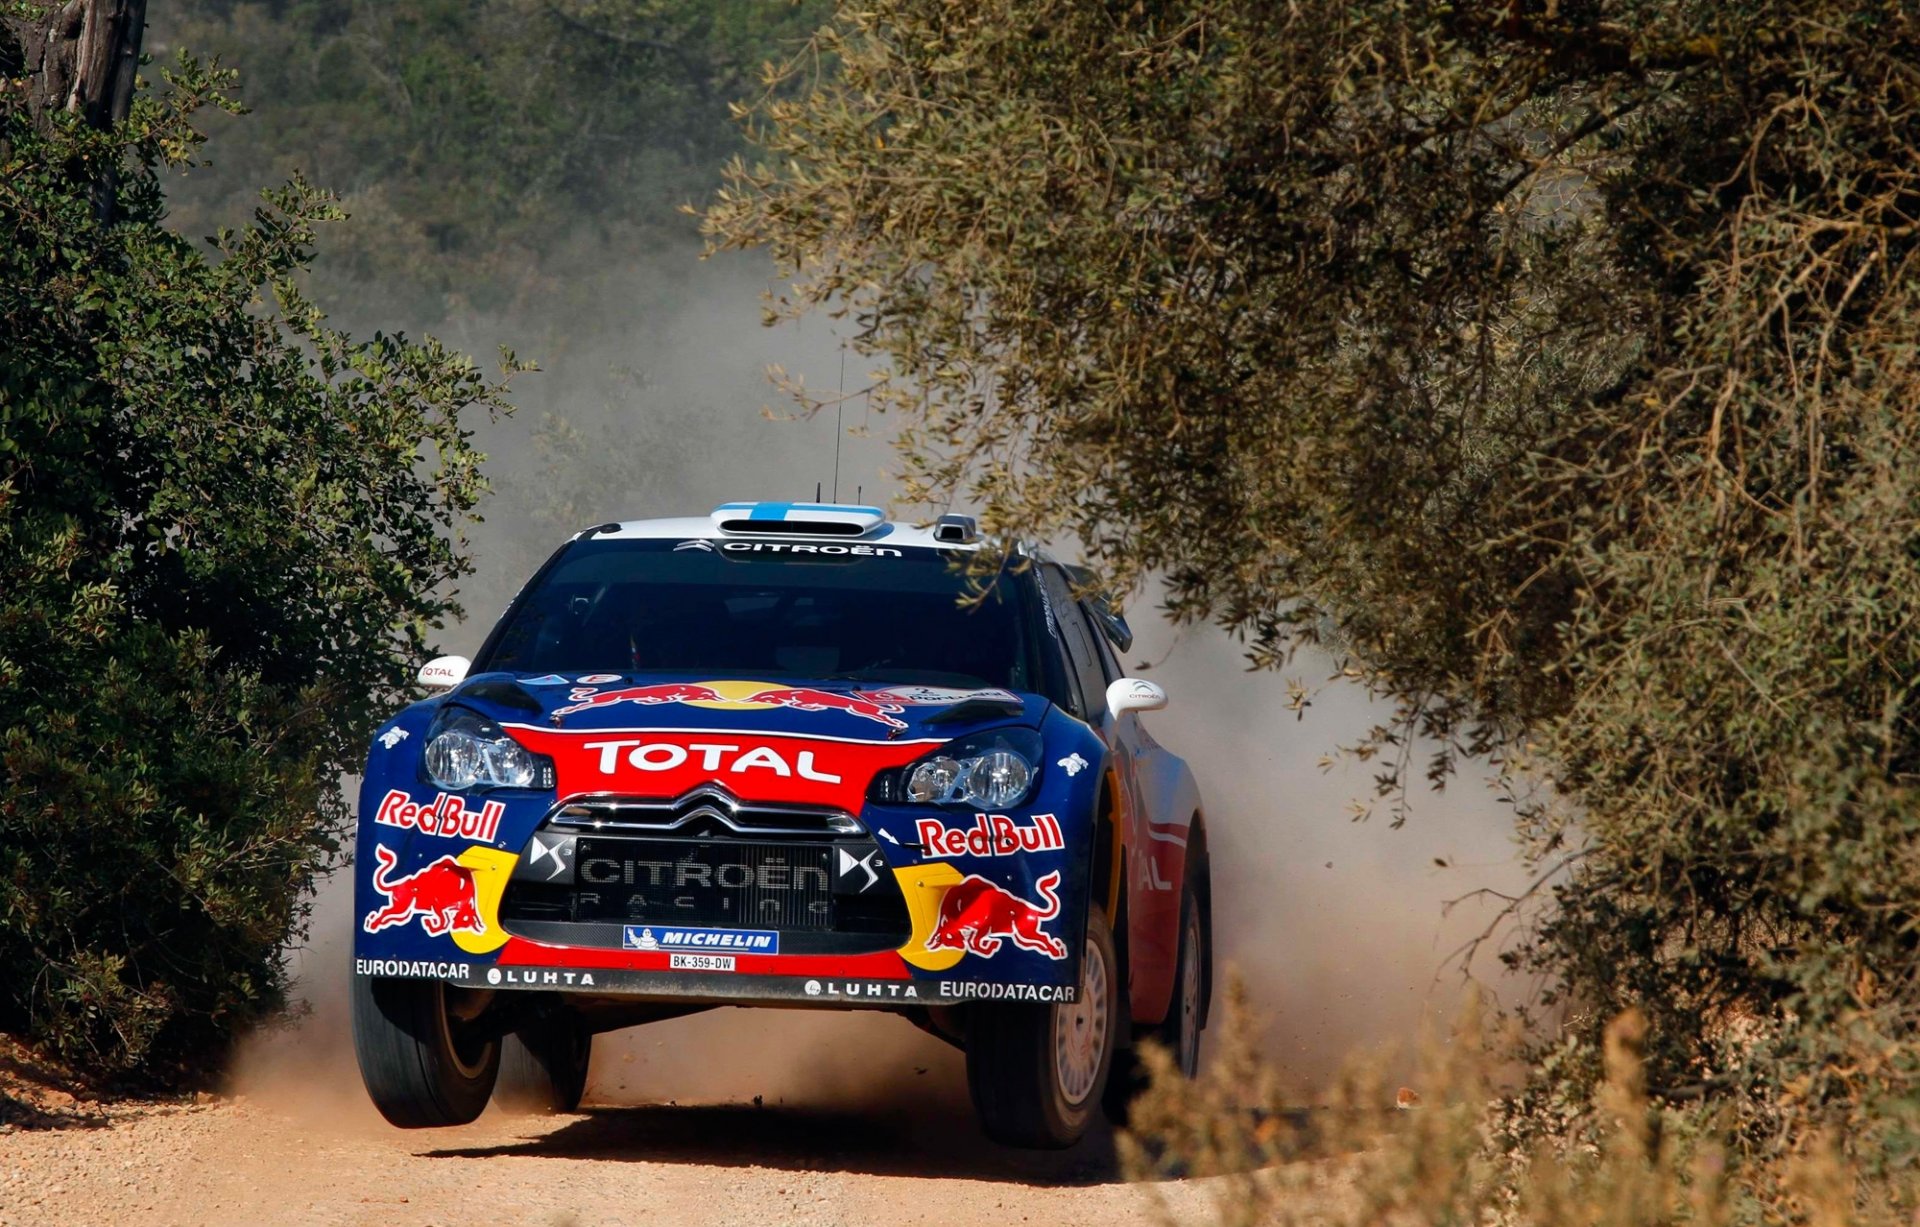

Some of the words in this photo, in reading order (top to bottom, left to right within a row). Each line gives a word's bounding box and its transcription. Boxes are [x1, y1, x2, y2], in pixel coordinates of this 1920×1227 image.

[423, 667, 454, 677] TOTAL
[583, 739, 841, 784] TOTAL
[375, 789, 447, 835] Red
[438, 795, 506, 843] Bull
[915, 814, 991, 858] Red
[989, 814, 1065, 856] Bull
[662, 931, 771, 948] MICHELIN
[356, 958, 469, 979] EURODATACAR
[673, 955, 732, 969] BK-359-DW
[507, 970, 595, 985] LUHTA
[828, 983, 918, 998] LUHTA
[940, 981, 1075, 1002] EURODATACAR
